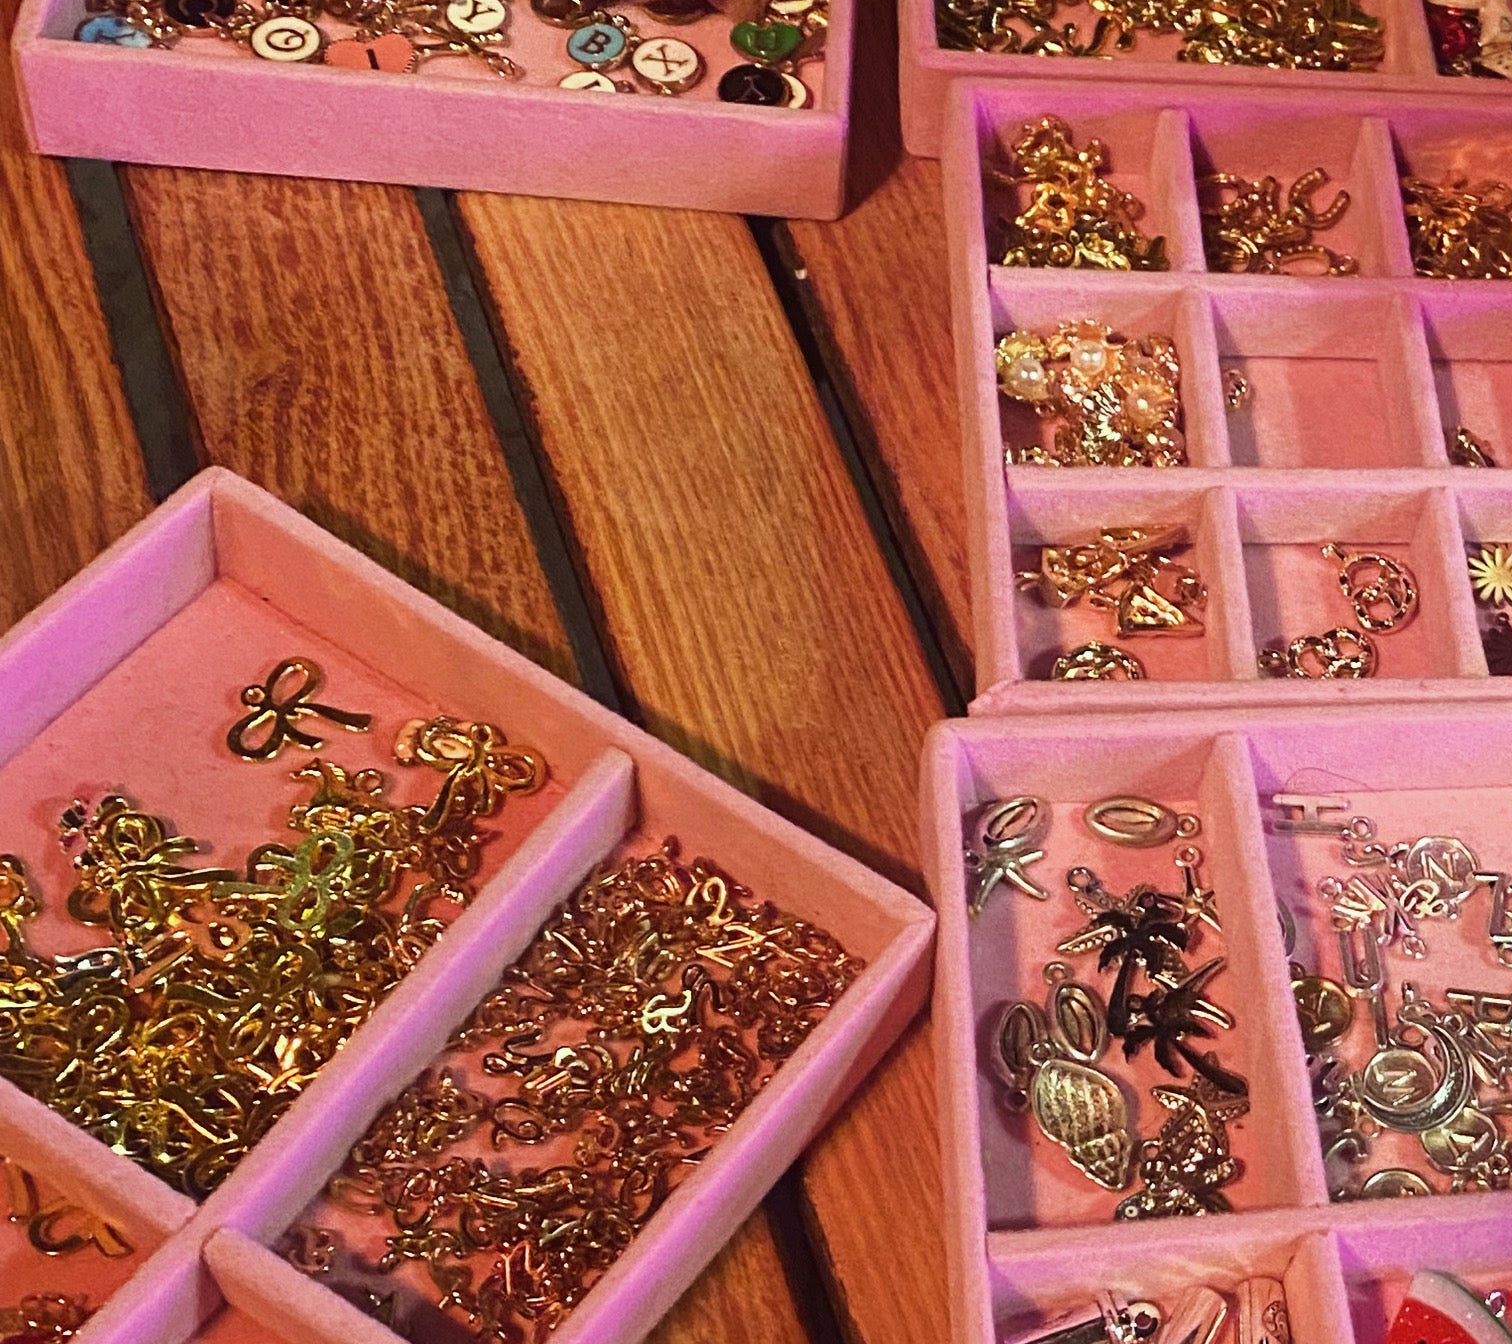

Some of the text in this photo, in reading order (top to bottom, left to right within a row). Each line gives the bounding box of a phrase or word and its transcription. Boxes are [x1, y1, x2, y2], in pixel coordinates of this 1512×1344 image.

[265, 26, 310, 53] Q
[577, 29, 612, 55] B
[641, 44, 690, 77] X
